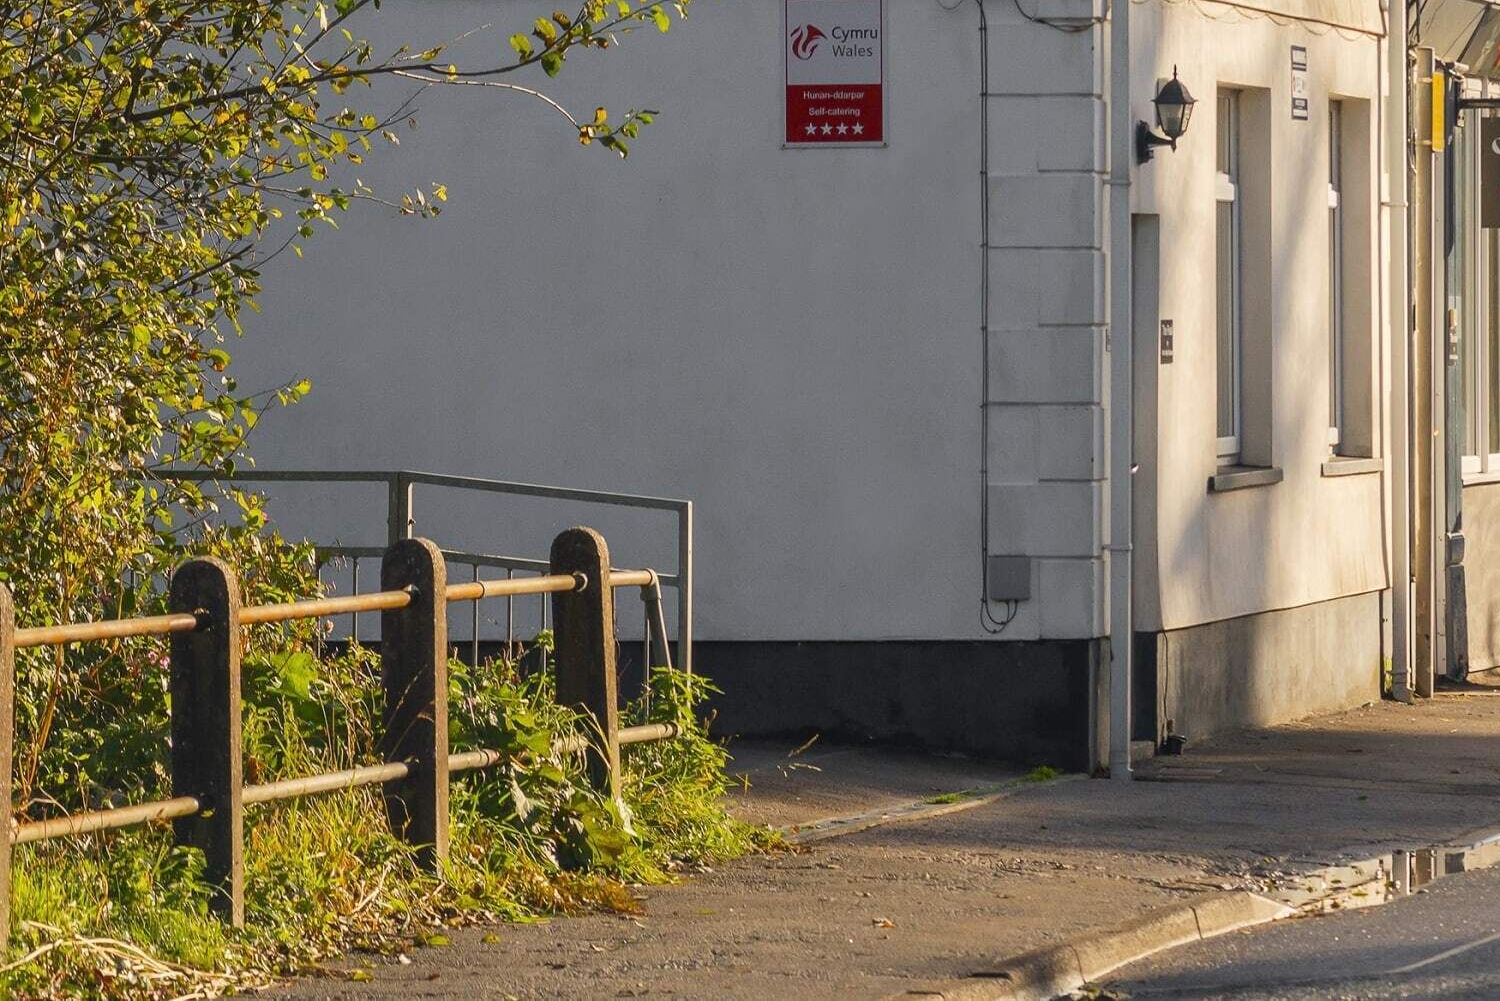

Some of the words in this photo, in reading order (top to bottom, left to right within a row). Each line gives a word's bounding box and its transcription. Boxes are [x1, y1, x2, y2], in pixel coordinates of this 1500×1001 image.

[831, 26, 878, 42] Cymru
[832, 45, 873, 57] Wales
[808, 107, 861, 116] Self-catering
